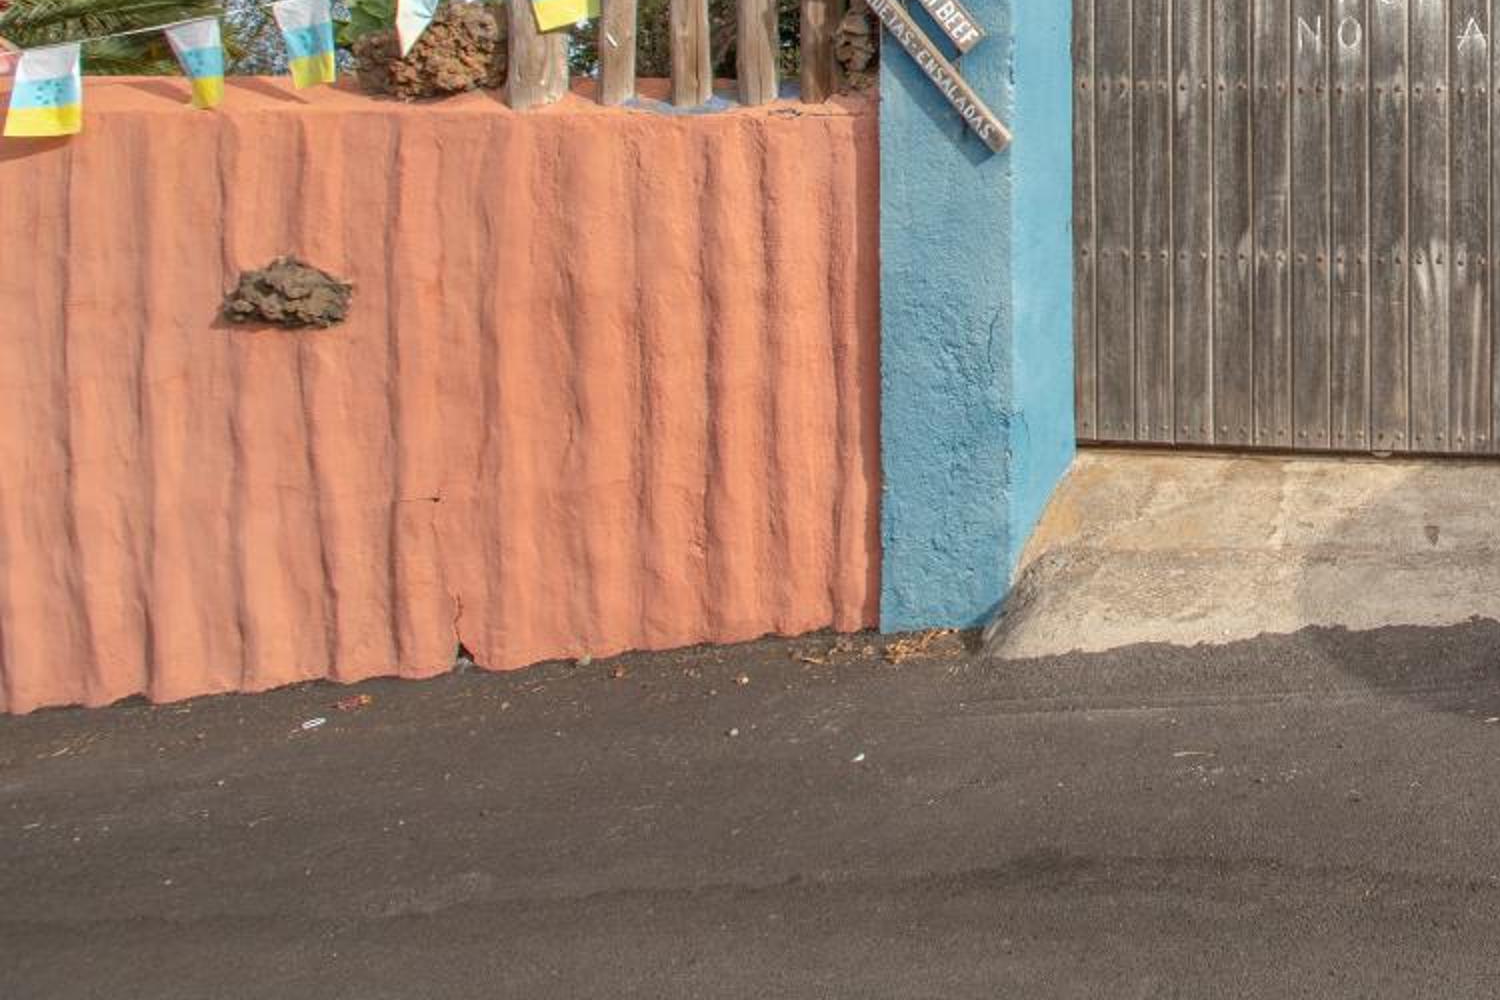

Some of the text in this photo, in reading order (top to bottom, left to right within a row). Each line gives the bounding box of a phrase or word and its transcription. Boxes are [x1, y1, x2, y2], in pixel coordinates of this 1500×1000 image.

[936, 0, 979, 45] BEEF
[1297, 15, 1363, 53] NO
[916, 49, 993, 140] ENSALADAS
